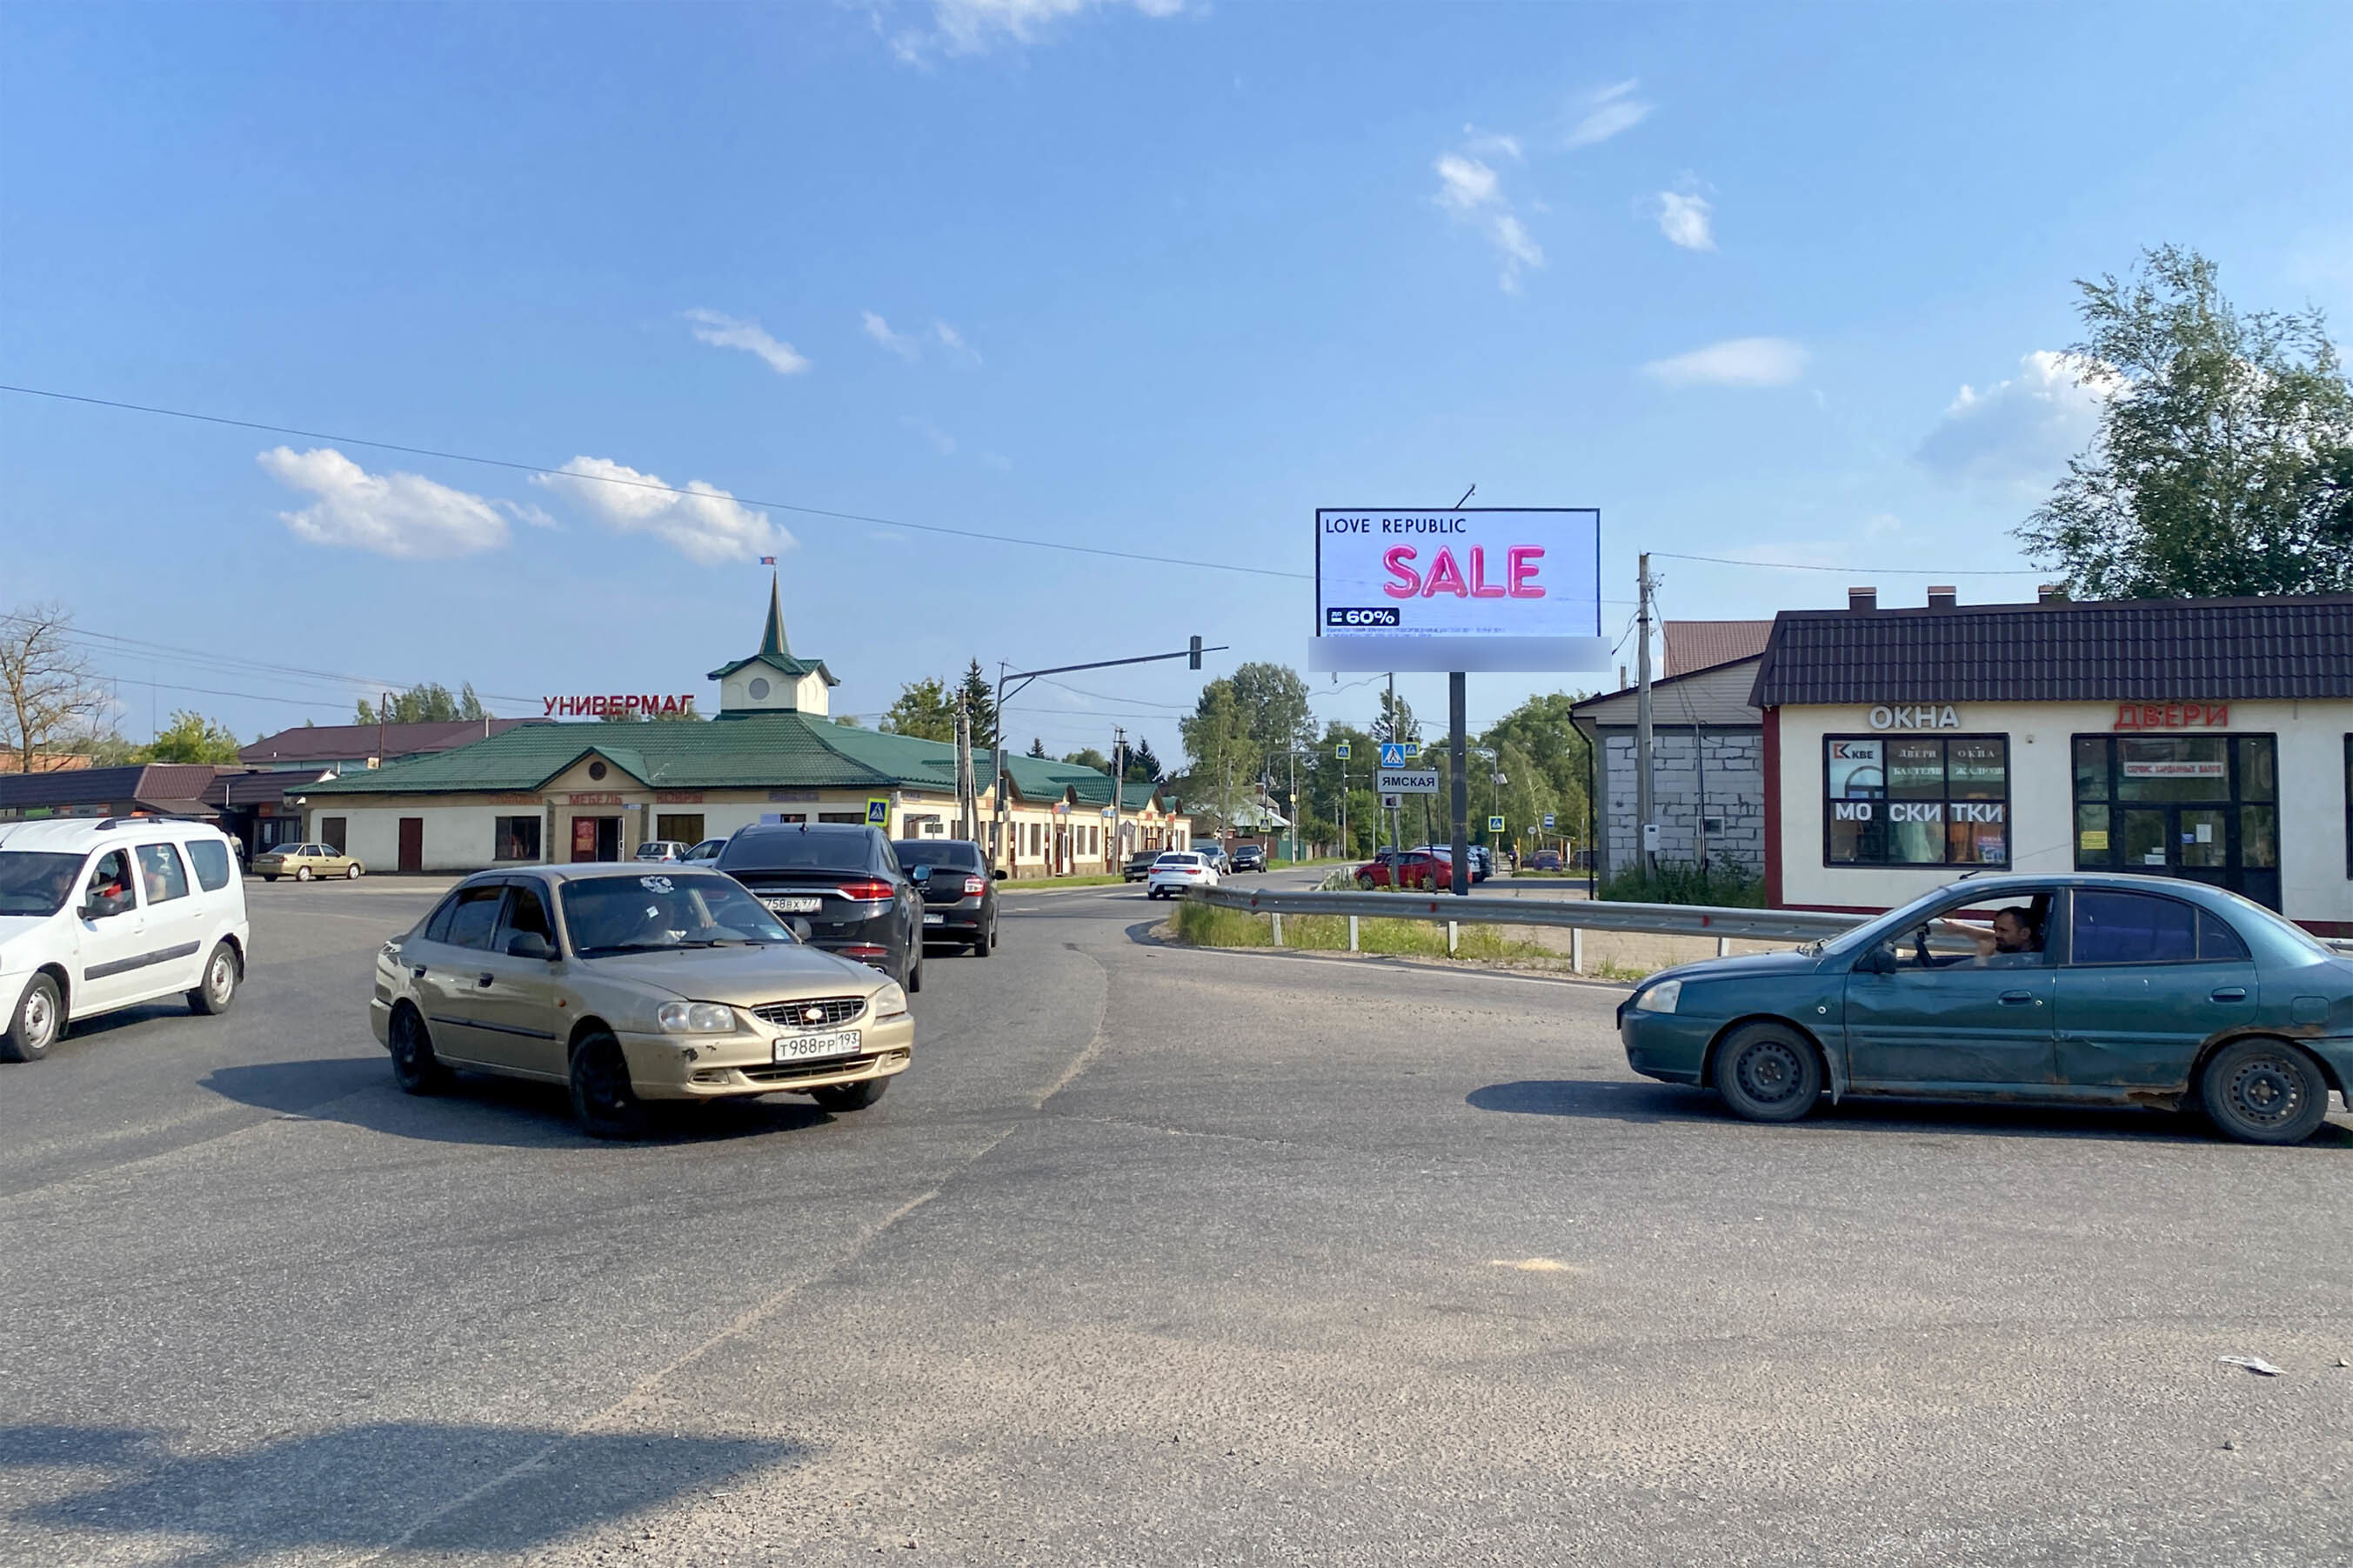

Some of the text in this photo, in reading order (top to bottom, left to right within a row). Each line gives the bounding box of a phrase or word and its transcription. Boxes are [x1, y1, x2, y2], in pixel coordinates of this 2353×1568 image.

[1326, 518, 1467, 534] LOVE REPUBLIC
[1383, 544, 1547, 599] SALE
[543, 694, 694, 716] УНИВЕРМАГ
[1869, 705, 1960, 729] ОКНА
[2114, 704, 2229, 731] ДВЕРИ
[1899, 750, 1936, 758] ДВЕРИ
[1957, 750, 1995, 758] ОКНА
[1382, 777, 1435, 787] ЯМСКАЯ
[569, 793, 623, 805] МЕБЕЛЬ
